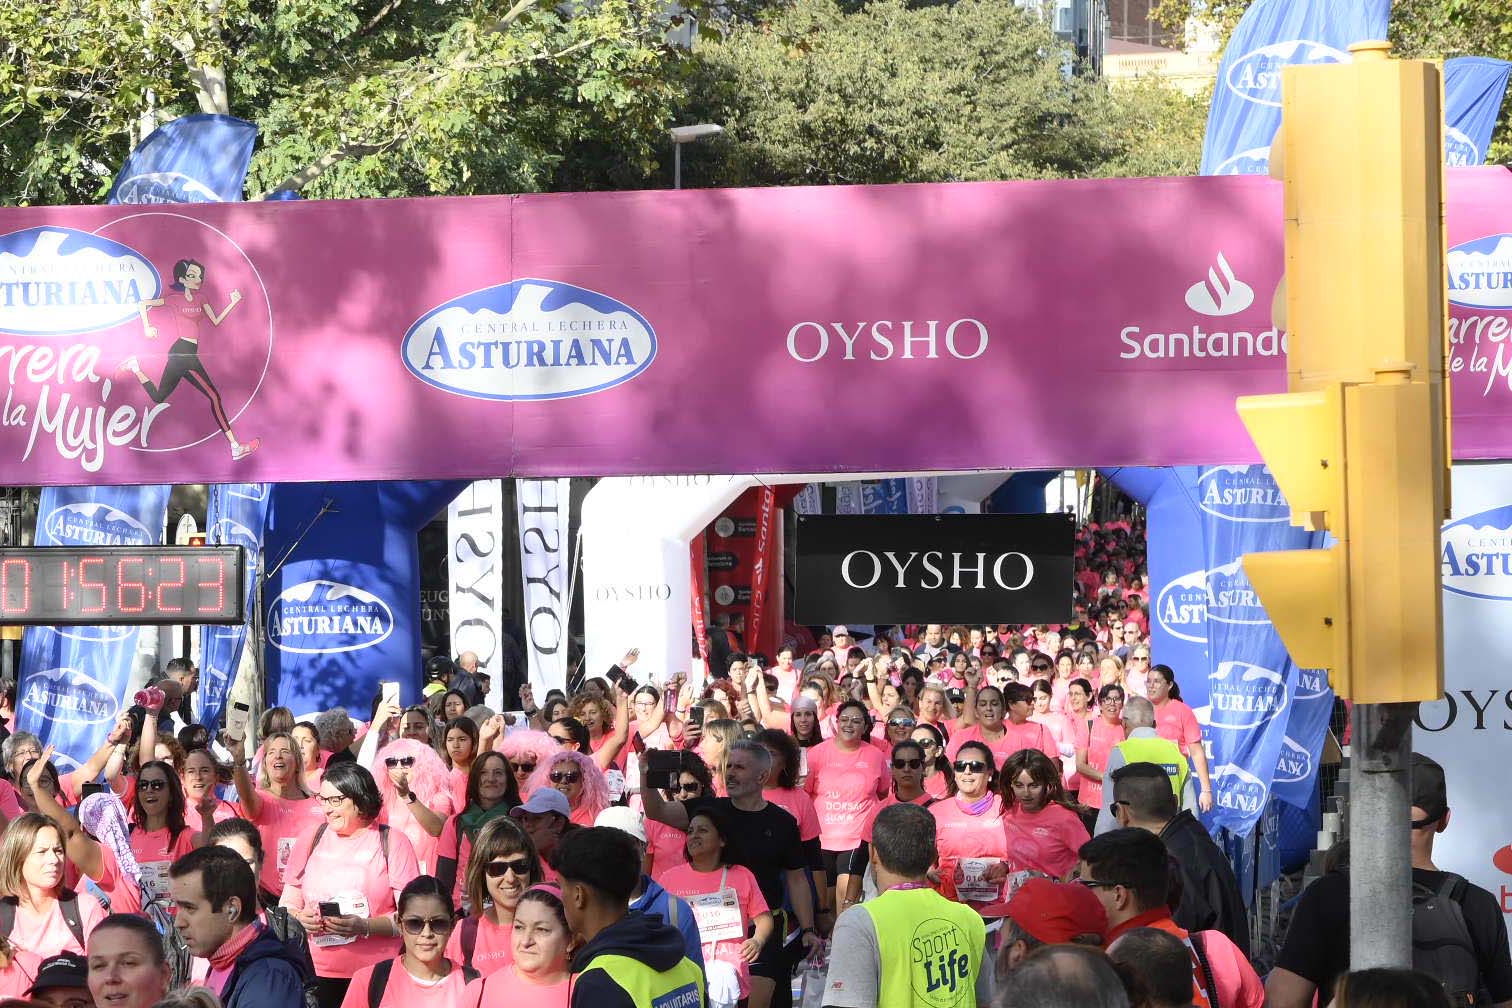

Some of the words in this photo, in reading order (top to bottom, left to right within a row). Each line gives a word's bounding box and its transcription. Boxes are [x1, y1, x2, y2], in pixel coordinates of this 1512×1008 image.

[459, 321, 542, 335] CENTRAL
[548, 320, 629, 333] LECHERA
[787, 318, 990, 363] OYSHO
[1119, 326, 1288, 359] Santand
[422, 326, 637, 371] ASTURIANA
[1, 389, 27, 428] la
[21, 382, 171, 473] Mujer
[841, 549, 1035, 591] OYSHO
[272, 611, 385, 638] ASTURIANA
[284, 605, 326, 614] CENTRAL
[330, 604, 380, 613] LECHERA
[913, 926, 960, 964] Sport
[924, 949, 970, 993] Life
